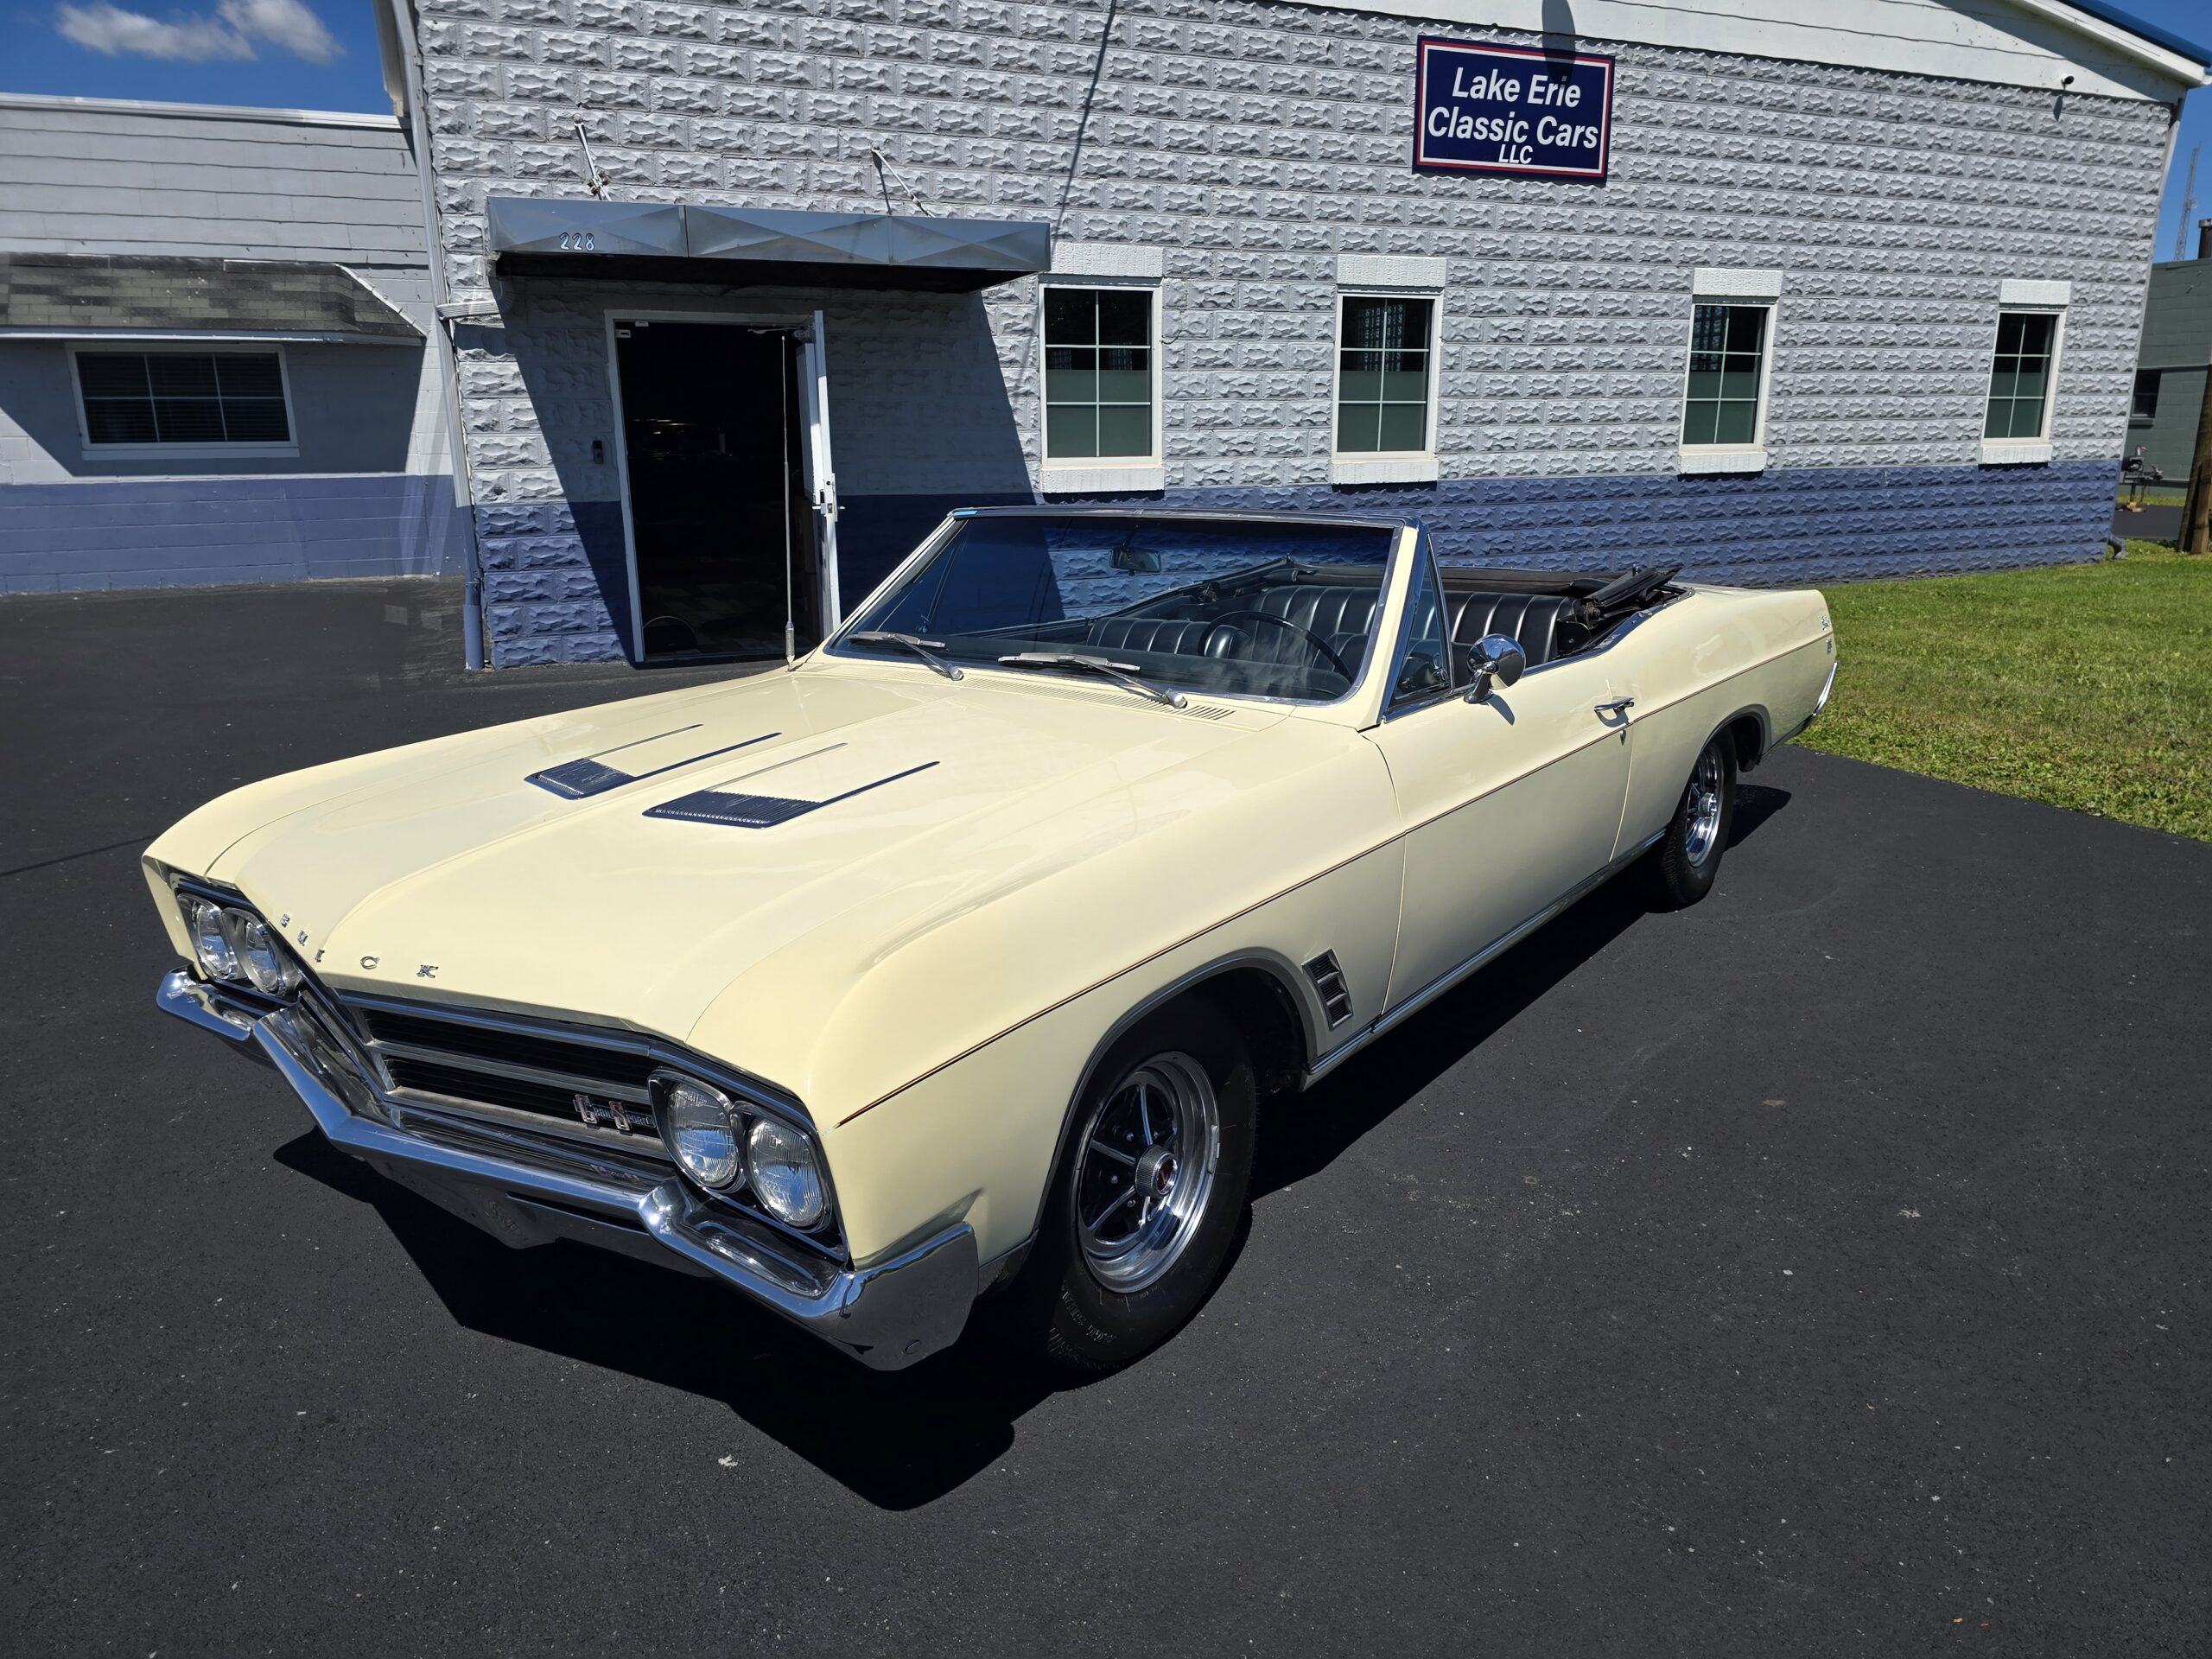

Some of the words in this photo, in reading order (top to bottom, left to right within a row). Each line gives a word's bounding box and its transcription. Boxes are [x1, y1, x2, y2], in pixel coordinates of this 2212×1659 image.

[1452, 67, 1520, 102] Lake
[1527, 74, 1580, 108] Erie
[1427, 106, 1529, 143] Classic
[1536, 116, 1599, 149] Cars
[1498, 144, 1534, 164] LLC
[559, 232, 595, 251] 228
[280, 913, 439, 979] BUICK
